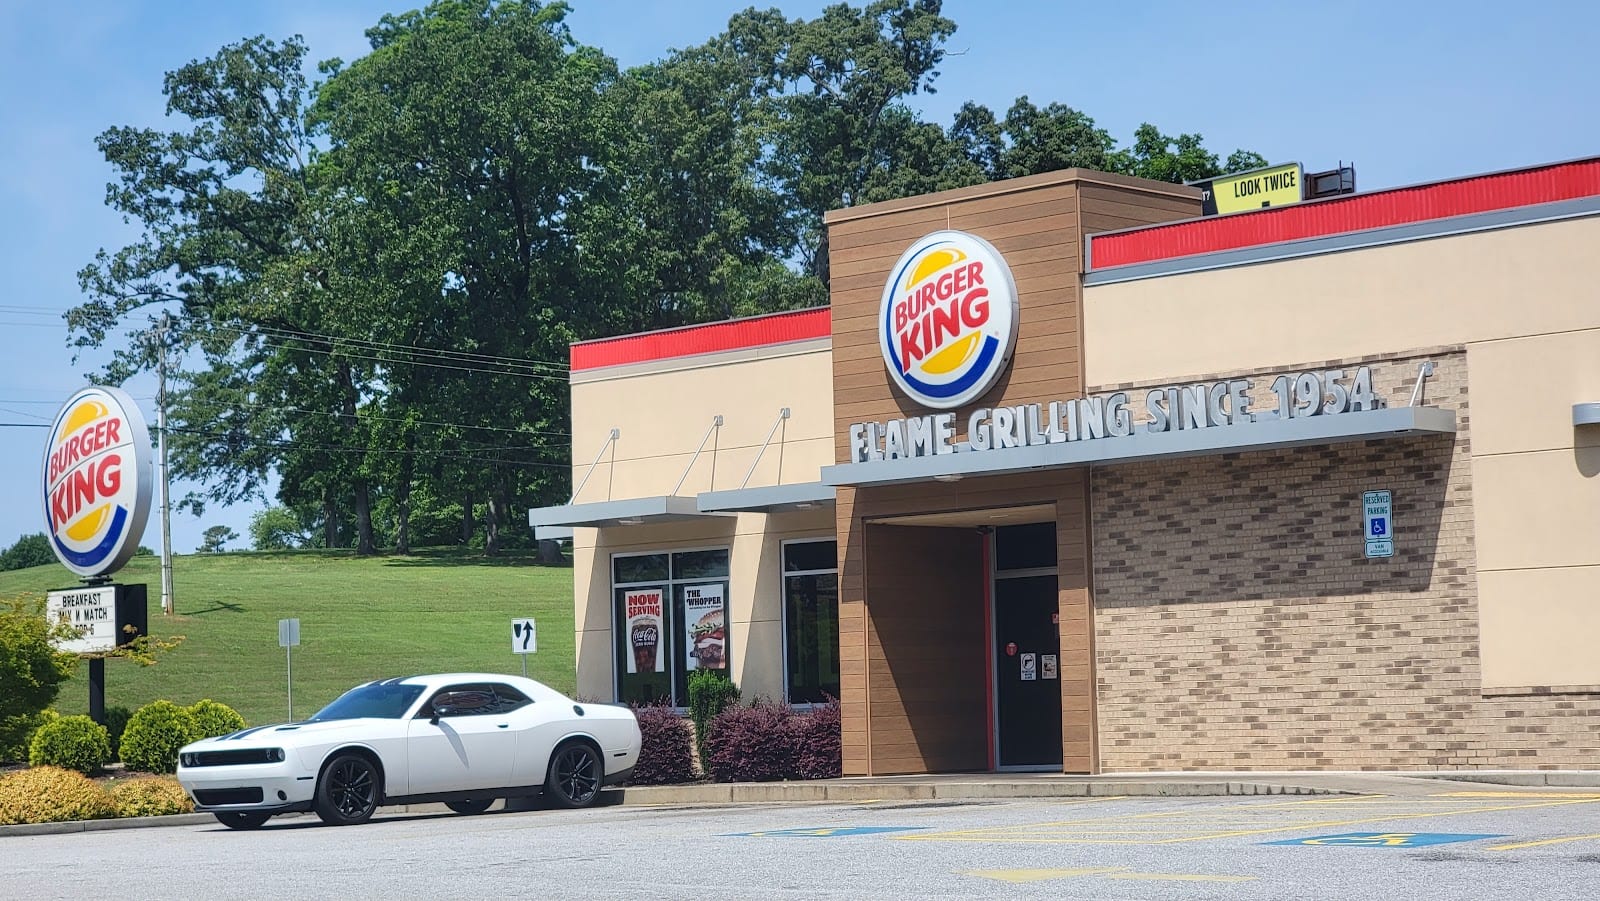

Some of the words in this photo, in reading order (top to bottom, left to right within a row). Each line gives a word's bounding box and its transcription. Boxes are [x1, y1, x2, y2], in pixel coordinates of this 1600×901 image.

[1234, 178, 1261, 198] LOOK
[1264, 171, 1296, 192] TWICE
[895, 261, 985, 334] BURGER
[900, 287, 990, 373] KING
[850, 412, 956, 464] FLAME
[967, 392, 1134, 451] GRILLING
[1146, 379, 1254, 433] SINCE
[1270, 366, 1376, 419] 1954
[49, 417, 122, 485] BURGER
[52, 453, 122, 537] KING
[1366, 495, 1388, 504] RESERVED
[1367, 507, 1388, 515] PARKING
[62, 593, 101, 607] BREAKFAST
[628, 593, 660, 606] NOW
[686, 589, 701, 598] THE
[686, 596, 722, 606] WHOPPER
[76, 610, 80, 621] N
[84, 607, 107, 621] MATCH
[628, 604, 660, 619] SERVING
